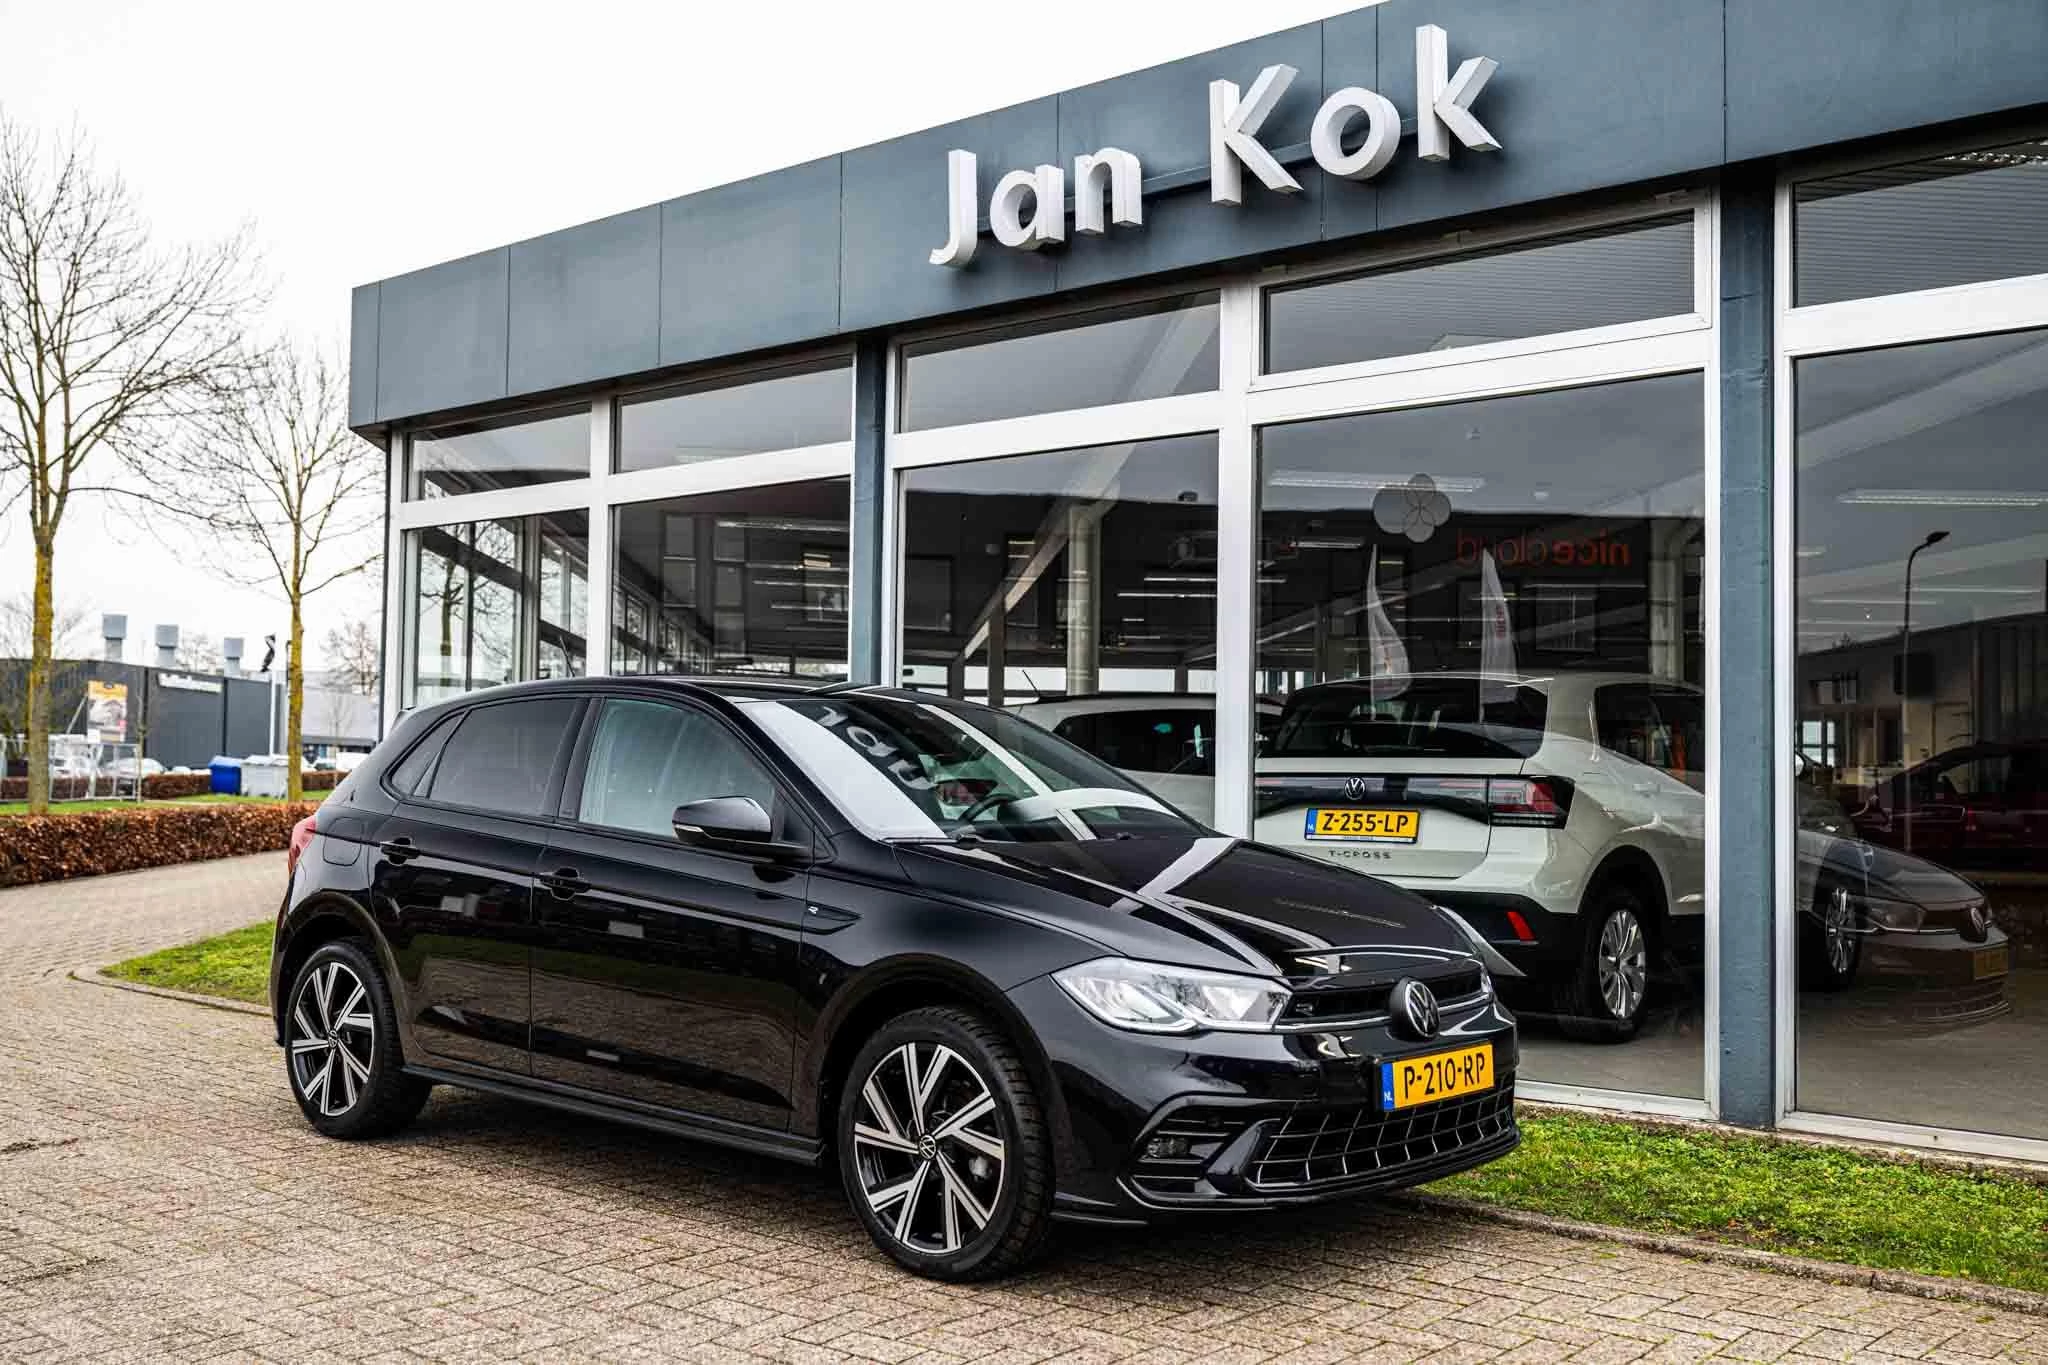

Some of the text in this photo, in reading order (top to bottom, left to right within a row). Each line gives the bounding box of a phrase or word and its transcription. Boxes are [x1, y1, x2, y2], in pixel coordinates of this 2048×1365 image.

[929, 23, 1502, 268] Jan Kok
[1322, 812, 1409, 833] Z-255-LP
[1328, 849, 1392, 860] T-CROSS
[1403, 1052, 1486, 1100] P-210-RP
